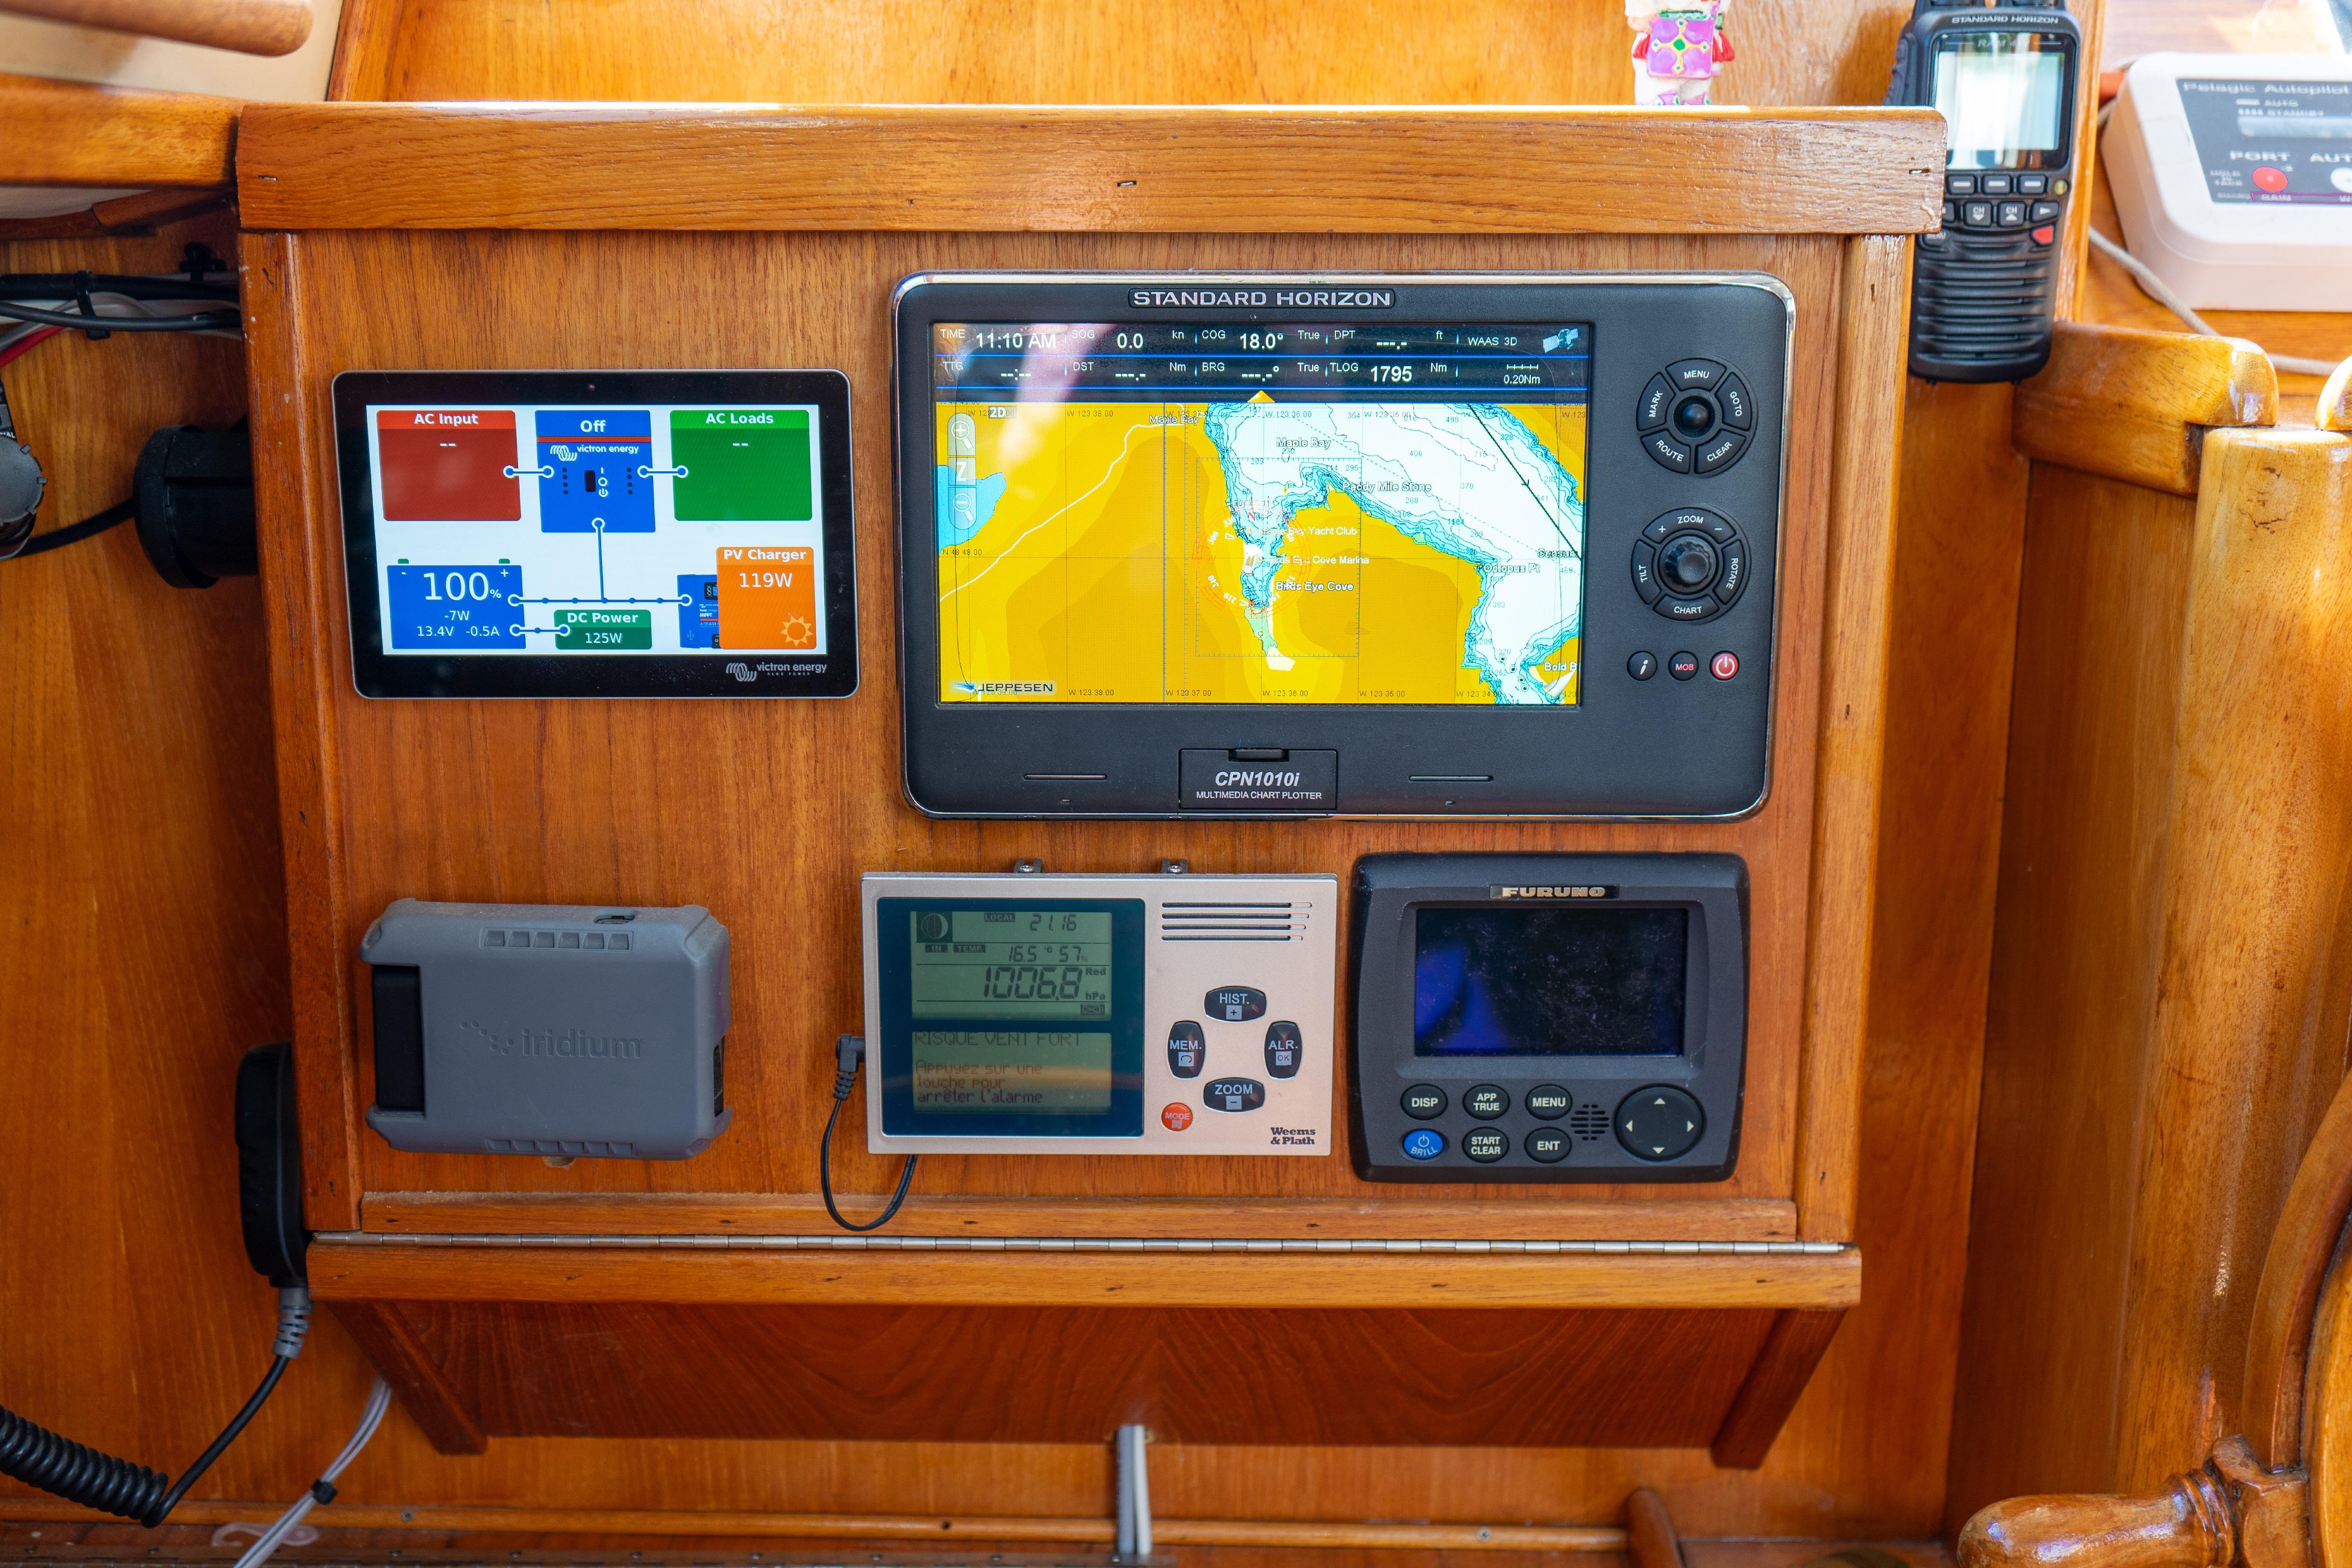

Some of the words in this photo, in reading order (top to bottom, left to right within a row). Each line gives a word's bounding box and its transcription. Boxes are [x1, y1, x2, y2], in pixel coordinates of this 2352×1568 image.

[2183, 82, 2256, 93] Pelagic
[2264, 83, 2351, 96] Autopilot
[2230, 151, 2292, 161] PORT
[1134, 292, 1266, 306] STANDARD
[1277, 292, 1390, 306] HORIZON
[940, 329, 965, 339] TIME
[976, 332, 1023, 349] 11:10
[1028, 333, 1056, 349] AM
[1071, 330, 1095, 339] SOG
[1117, 333, 1143, 349] 0.0
[1172, 330, 1184, 339] kn
[1202, 330, 1226, 339] COG
[1297, 330, 1320, 339] True
[1334, 330, 1355, 339] DPT
[1436, 330, 1443, 339] ft
[1468, 337, 1499, 346] WAAS
[1504, 337, 1517, 346] 3D
[942, 361, 963, 370] TTG
[1073, 362, 1094, 371] DST
[1170, 362, 1186, 372] Nm
[1202, 362, 1225, 372] BRG
[1297, 362, 1319, 372] True
[1330, 362, 1358, 372] TLOG
[1371, 366, 1412, 382] 1795
[1431, 363, 1447, 373] Nm
[1504, 375, 1540, 384] 0.20Nm
[1684, 370, 1710, 379] MENU
[1649, 391, 1663, 417] MARK
[1730, 391, 1742, 417] GOTO
[706, 414, 725, 424] AC
[731, 413, 774, 424] Loads
[989, 407, 1005, 418] 2D
[415, 414, 434, 424] AC
[439, 413, 478, 426] Input
[580, 420, 606, 432] Off
[577, 445, 606, 453] victron
[609, 445, 639, 454] energy
[1276, 437, 1308, 450] Maple
[1311, 437, 1331, 450] Bay
[1656, 440, 1684, 462] ROUTE
[1707, 441, 1733, 461] CLEAR
[1343, 482, 1375, 492] Paddy
[1378, 482, 1399, 491] Mile
[1402, 482, 1431, 492] Stone
[1677, 515, 1704, 524] ZOOM
[1308, 527, 1334, 535] Yacht
[1337, 526, 1357, 535] Club
[724, 550, 742, 560] PV
[747, 549, 807, 562] Charger
[1313, 556, 1337, 564] Cove
[1339, 556, 1369, 564] Marina
[1484, 563, 1525, 575] Octopus
[1528, 563, 1540, 573] Pt
[1638, 565, 1648, 582] TILT
[1726, 558, 1739, 590] ROTATE
[739, 573, 793, 588] 119W
[1304, 581, 1324, 594] Eye
[1327, 581, 1354, 591] Cove
[444, 611, 470, 621] -7W
[1674, 606, 1702, 614] CHART
[567, 612, 587, 624] DC
[592, 612, 638, 624] Power
[416, 626, 454, 637] 13.4V
[466, 626, 500, 637] -0.5A
[585, 632, 622, 644] 125W
[757, 663, 790, 671] victron
[794, 663, 827, 673] energy
[1544, 662, 1567, 671] Bold
[1215, 771, 1300, 787] CPN1010i
[1251, 791, 1281, 799] CHART
[1282, 792, 1322, 800] PLOTTER
[1502, 887, 1606, 897] FURUNO
[1009, 946, 1037, 963] 16.5
[1085, 967, 1106, 976] Red
[984, 967, 1083, 1001] 1006.8
[1085, 991, 1106, 1000] hPa
[1219, 993, 1250, 1004] HIST.
[521, 1028, 641, 1059] iridium
[915, 1033, 978, 1046] RISQUE
[985, 1033, 1028, 1046] VENT
[1037, 1033, 1081, 1046] FORT
[1170, 1040, 1202, 1050] MEM.
[1268, 1040, 1298, 1050] ALR.
[985, 1063, 1012, 1075] sur
[1017, 1063, 1043, 1075] une
[917, 1076, 965, 1088] touche
[1215, 1085, 1252, 1094] ZOOM
[918, 1089, 974, 1103] arrêter
[981, 1089, 1043, 1103] l'alarme
[1411, 1098, 1438, 1107] DISP
[1532, 1098, 1566, 1107] MENU
[1410, 1146, 1438, 1157] BRILL
[1471, 1146, 1500, 1155] CLEAR
[1537, 1141, 1560, 1151] ENT
